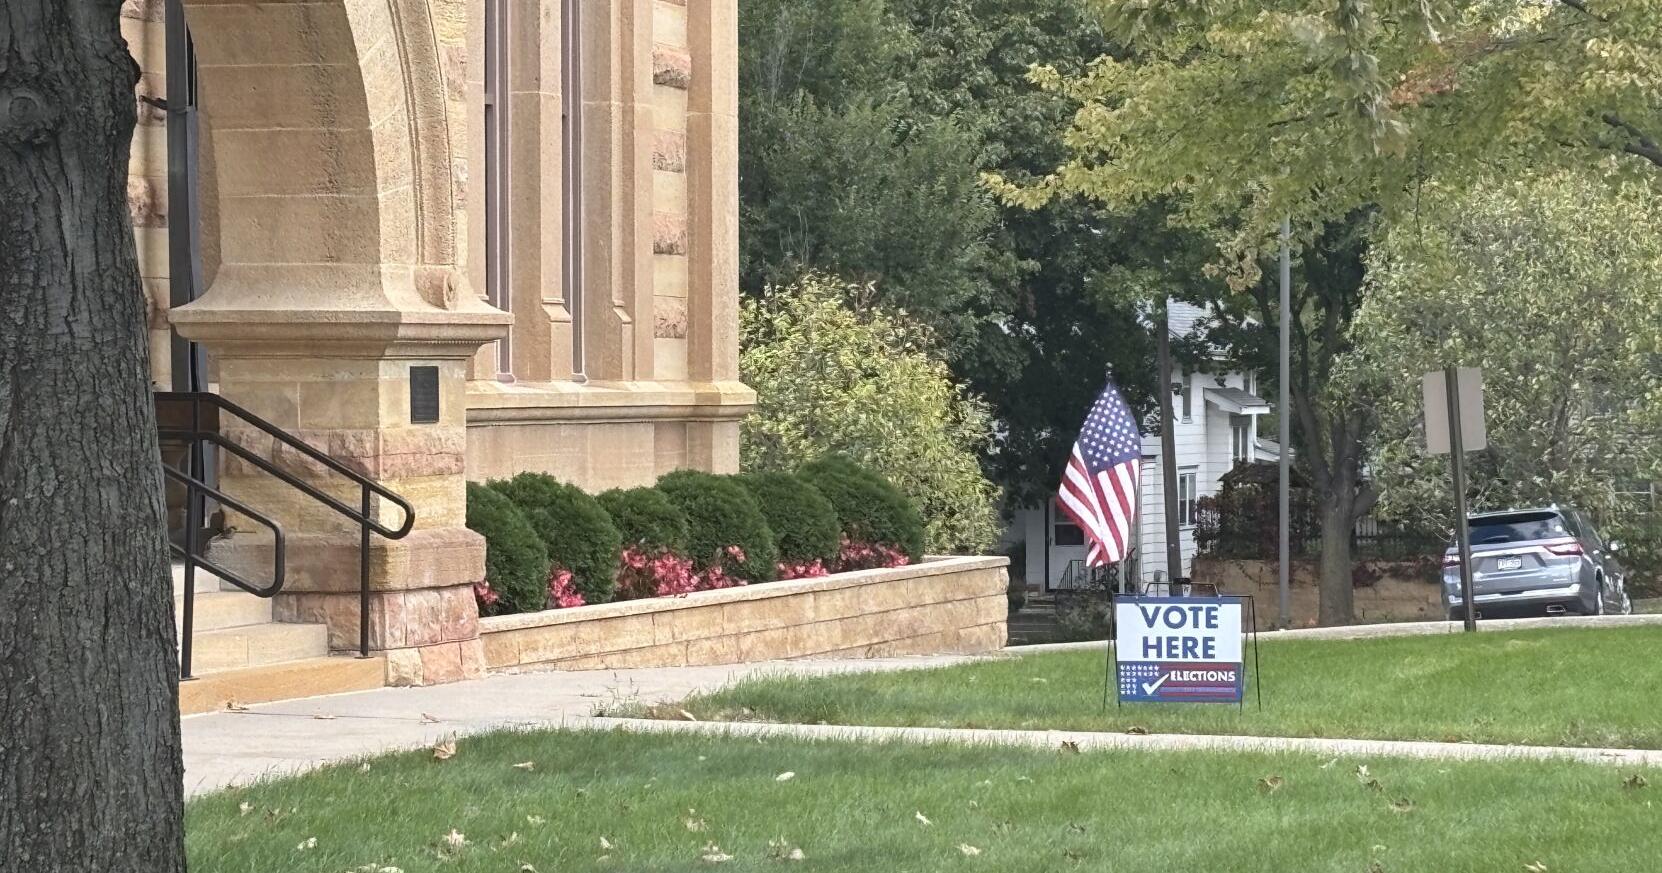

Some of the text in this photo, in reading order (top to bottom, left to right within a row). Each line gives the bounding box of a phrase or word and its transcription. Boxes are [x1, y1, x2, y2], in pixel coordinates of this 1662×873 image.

[1140, 605, 1219, 629] VOTE
[1142, 636, 1216, 659] HERE
[1169, 670, 1236, 682] ELECTIONS
